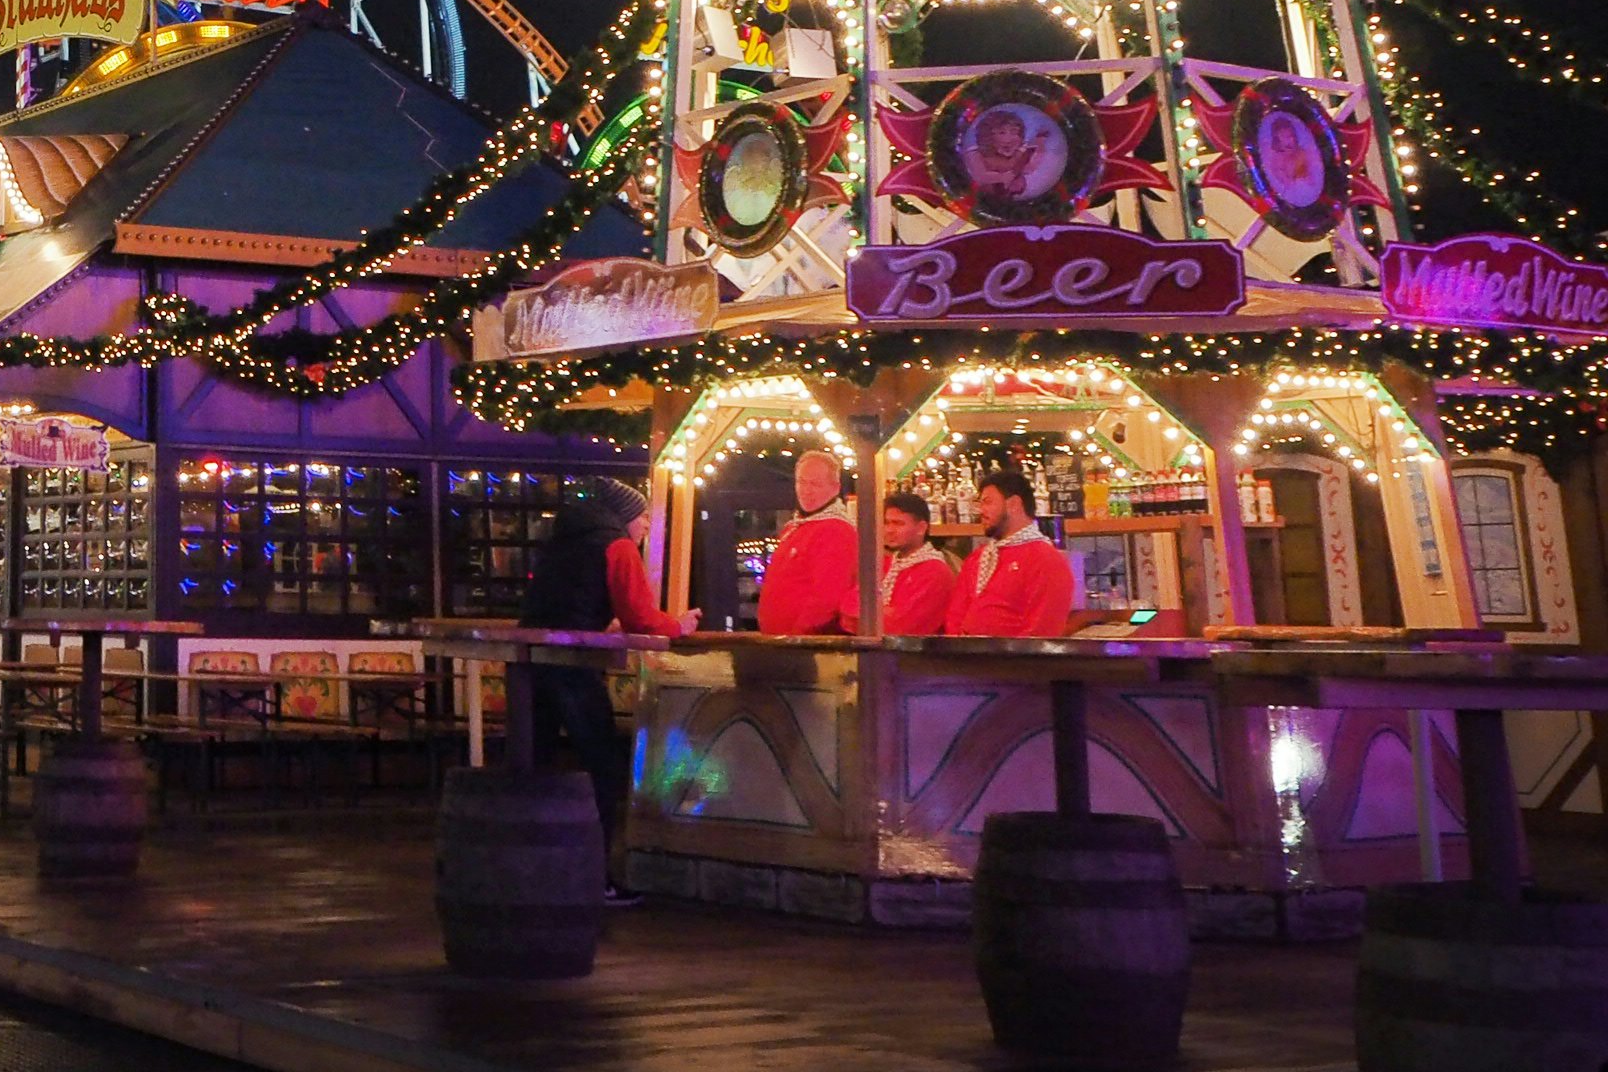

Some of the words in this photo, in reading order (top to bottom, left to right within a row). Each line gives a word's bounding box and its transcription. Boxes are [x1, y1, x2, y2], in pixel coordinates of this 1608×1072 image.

[875, 248, 1204, 319] Beer
[1531, 255, 1608, 324] Wine
[11, 427, 57, 462] Mulled
[61, 428, 98, 461] Wine
